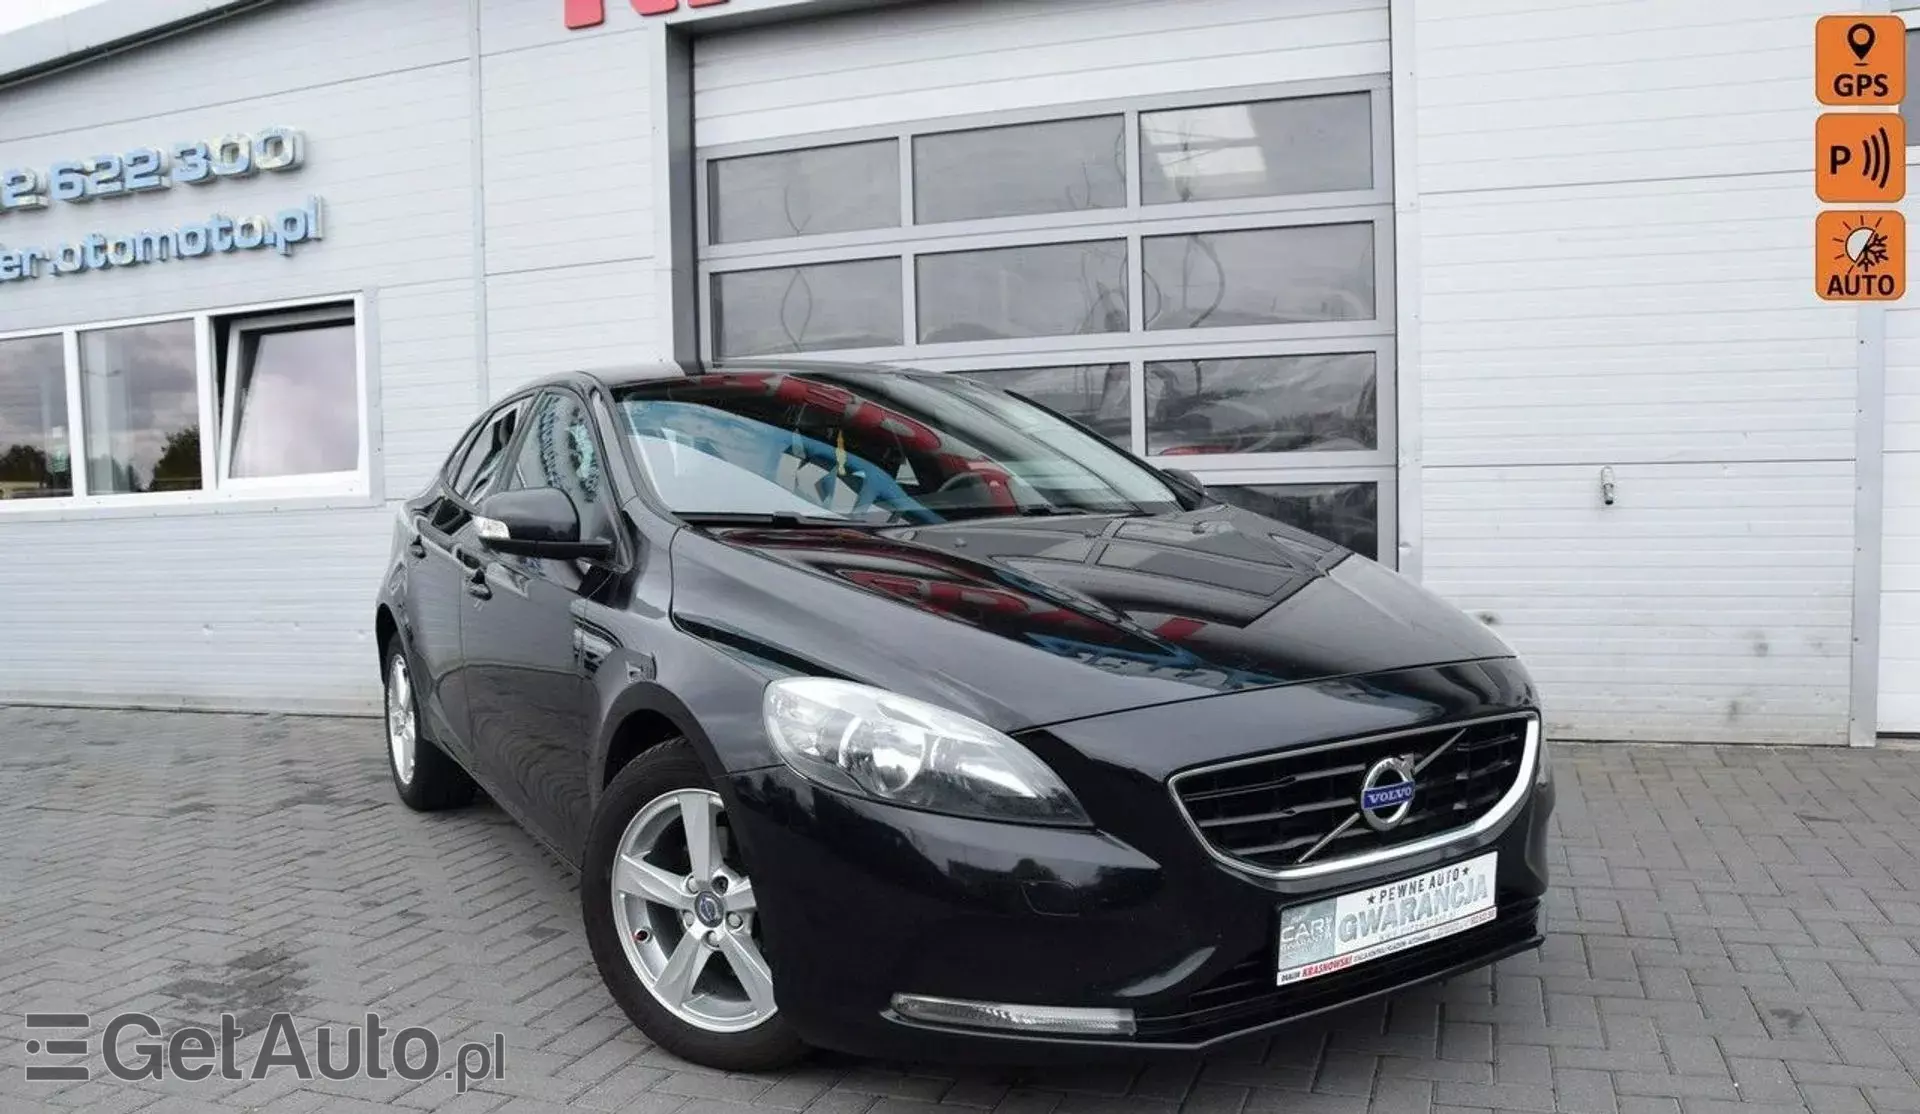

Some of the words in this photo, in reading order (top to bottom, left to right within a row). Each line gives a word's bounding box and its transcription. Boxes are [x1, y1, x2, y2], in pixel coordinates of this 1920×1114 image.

[50, 147, 170, 204] 622
[171, 125, 305, 185] 300
[1367, 786, 1412, 803] VOLVO
[1338, 873, 1488, 943] GWARANCJA
[1379, 877, 1425, 903] PEWNE
[1429, 868, 1460, 890] AUTO
